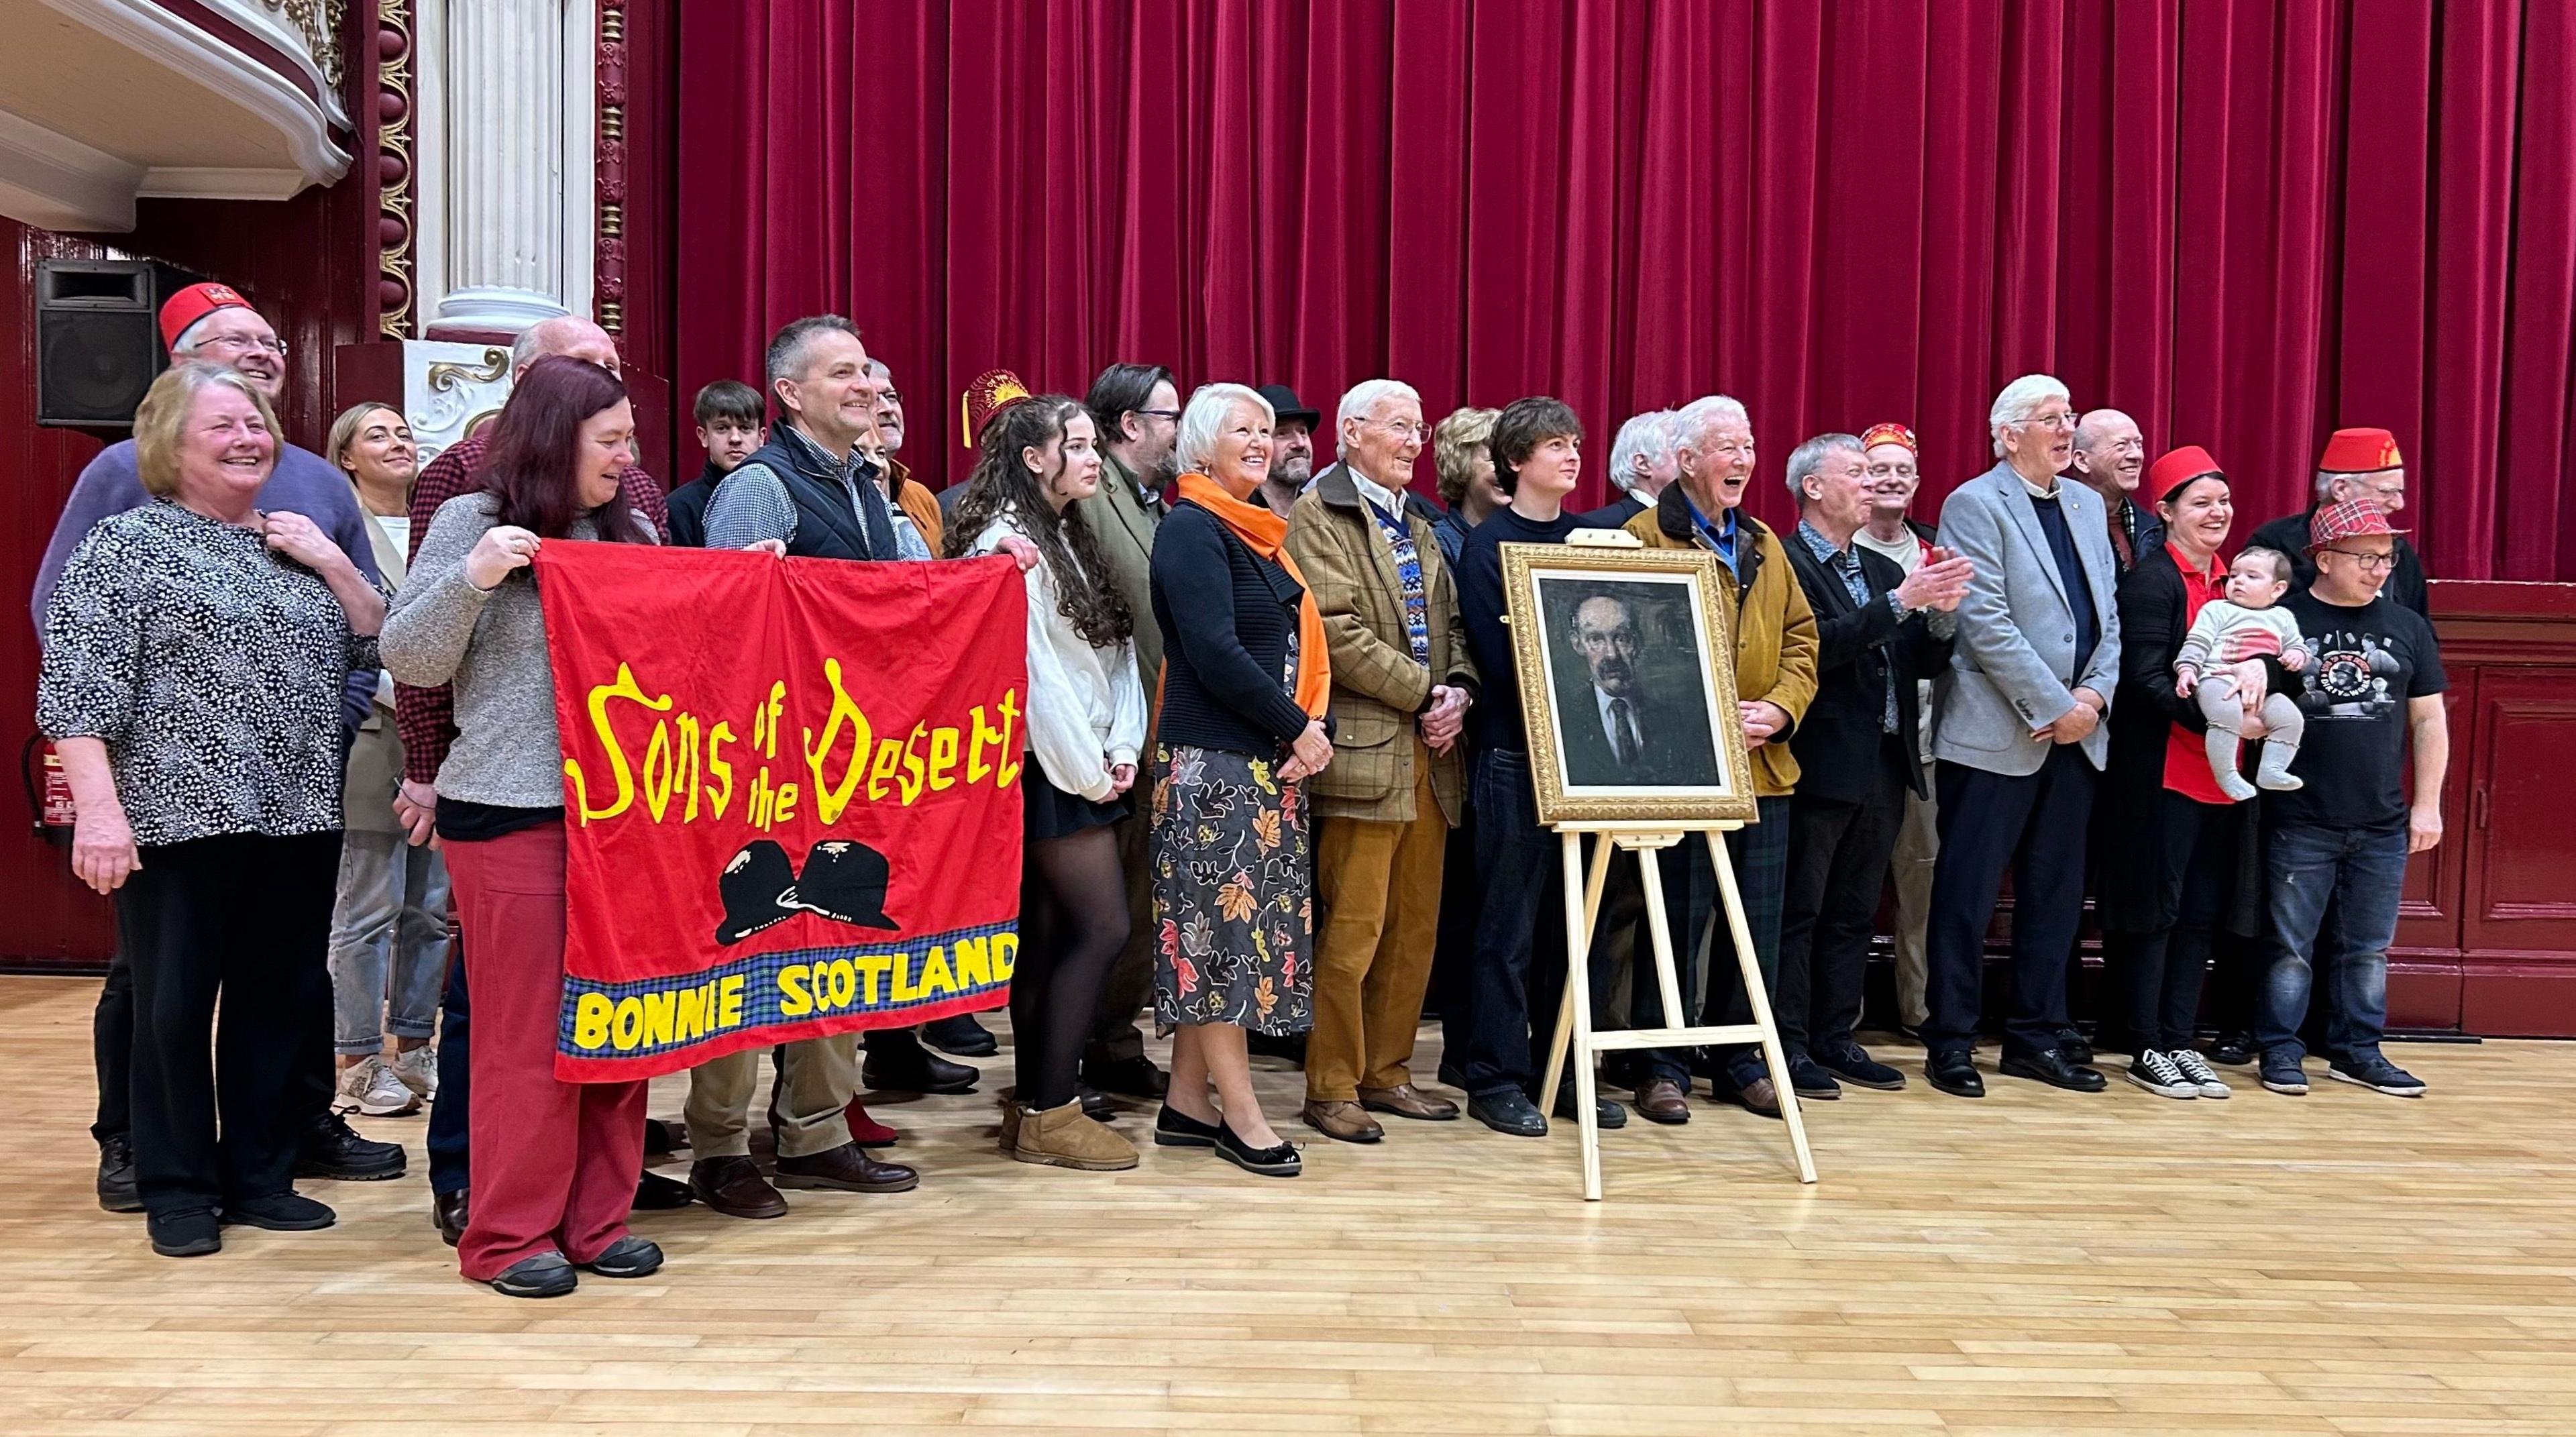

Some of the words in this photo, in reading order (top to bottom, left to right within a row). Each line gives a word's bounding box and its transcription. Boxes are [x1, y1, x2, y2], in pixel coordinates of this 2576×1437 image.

[754, 680, 786, 759] of
[2320, 678, 2344, 696] DIRTY
[2349, 680, 2371, 696] WORK
[564, 661, 738, 827] Sons
[803, 657, 1022, 827] Desert
[747, 766, 798, 833] the
[574, 974, 744, 1051] BONNIE
[777, 933, 1019, 1016] SCOTLAND
